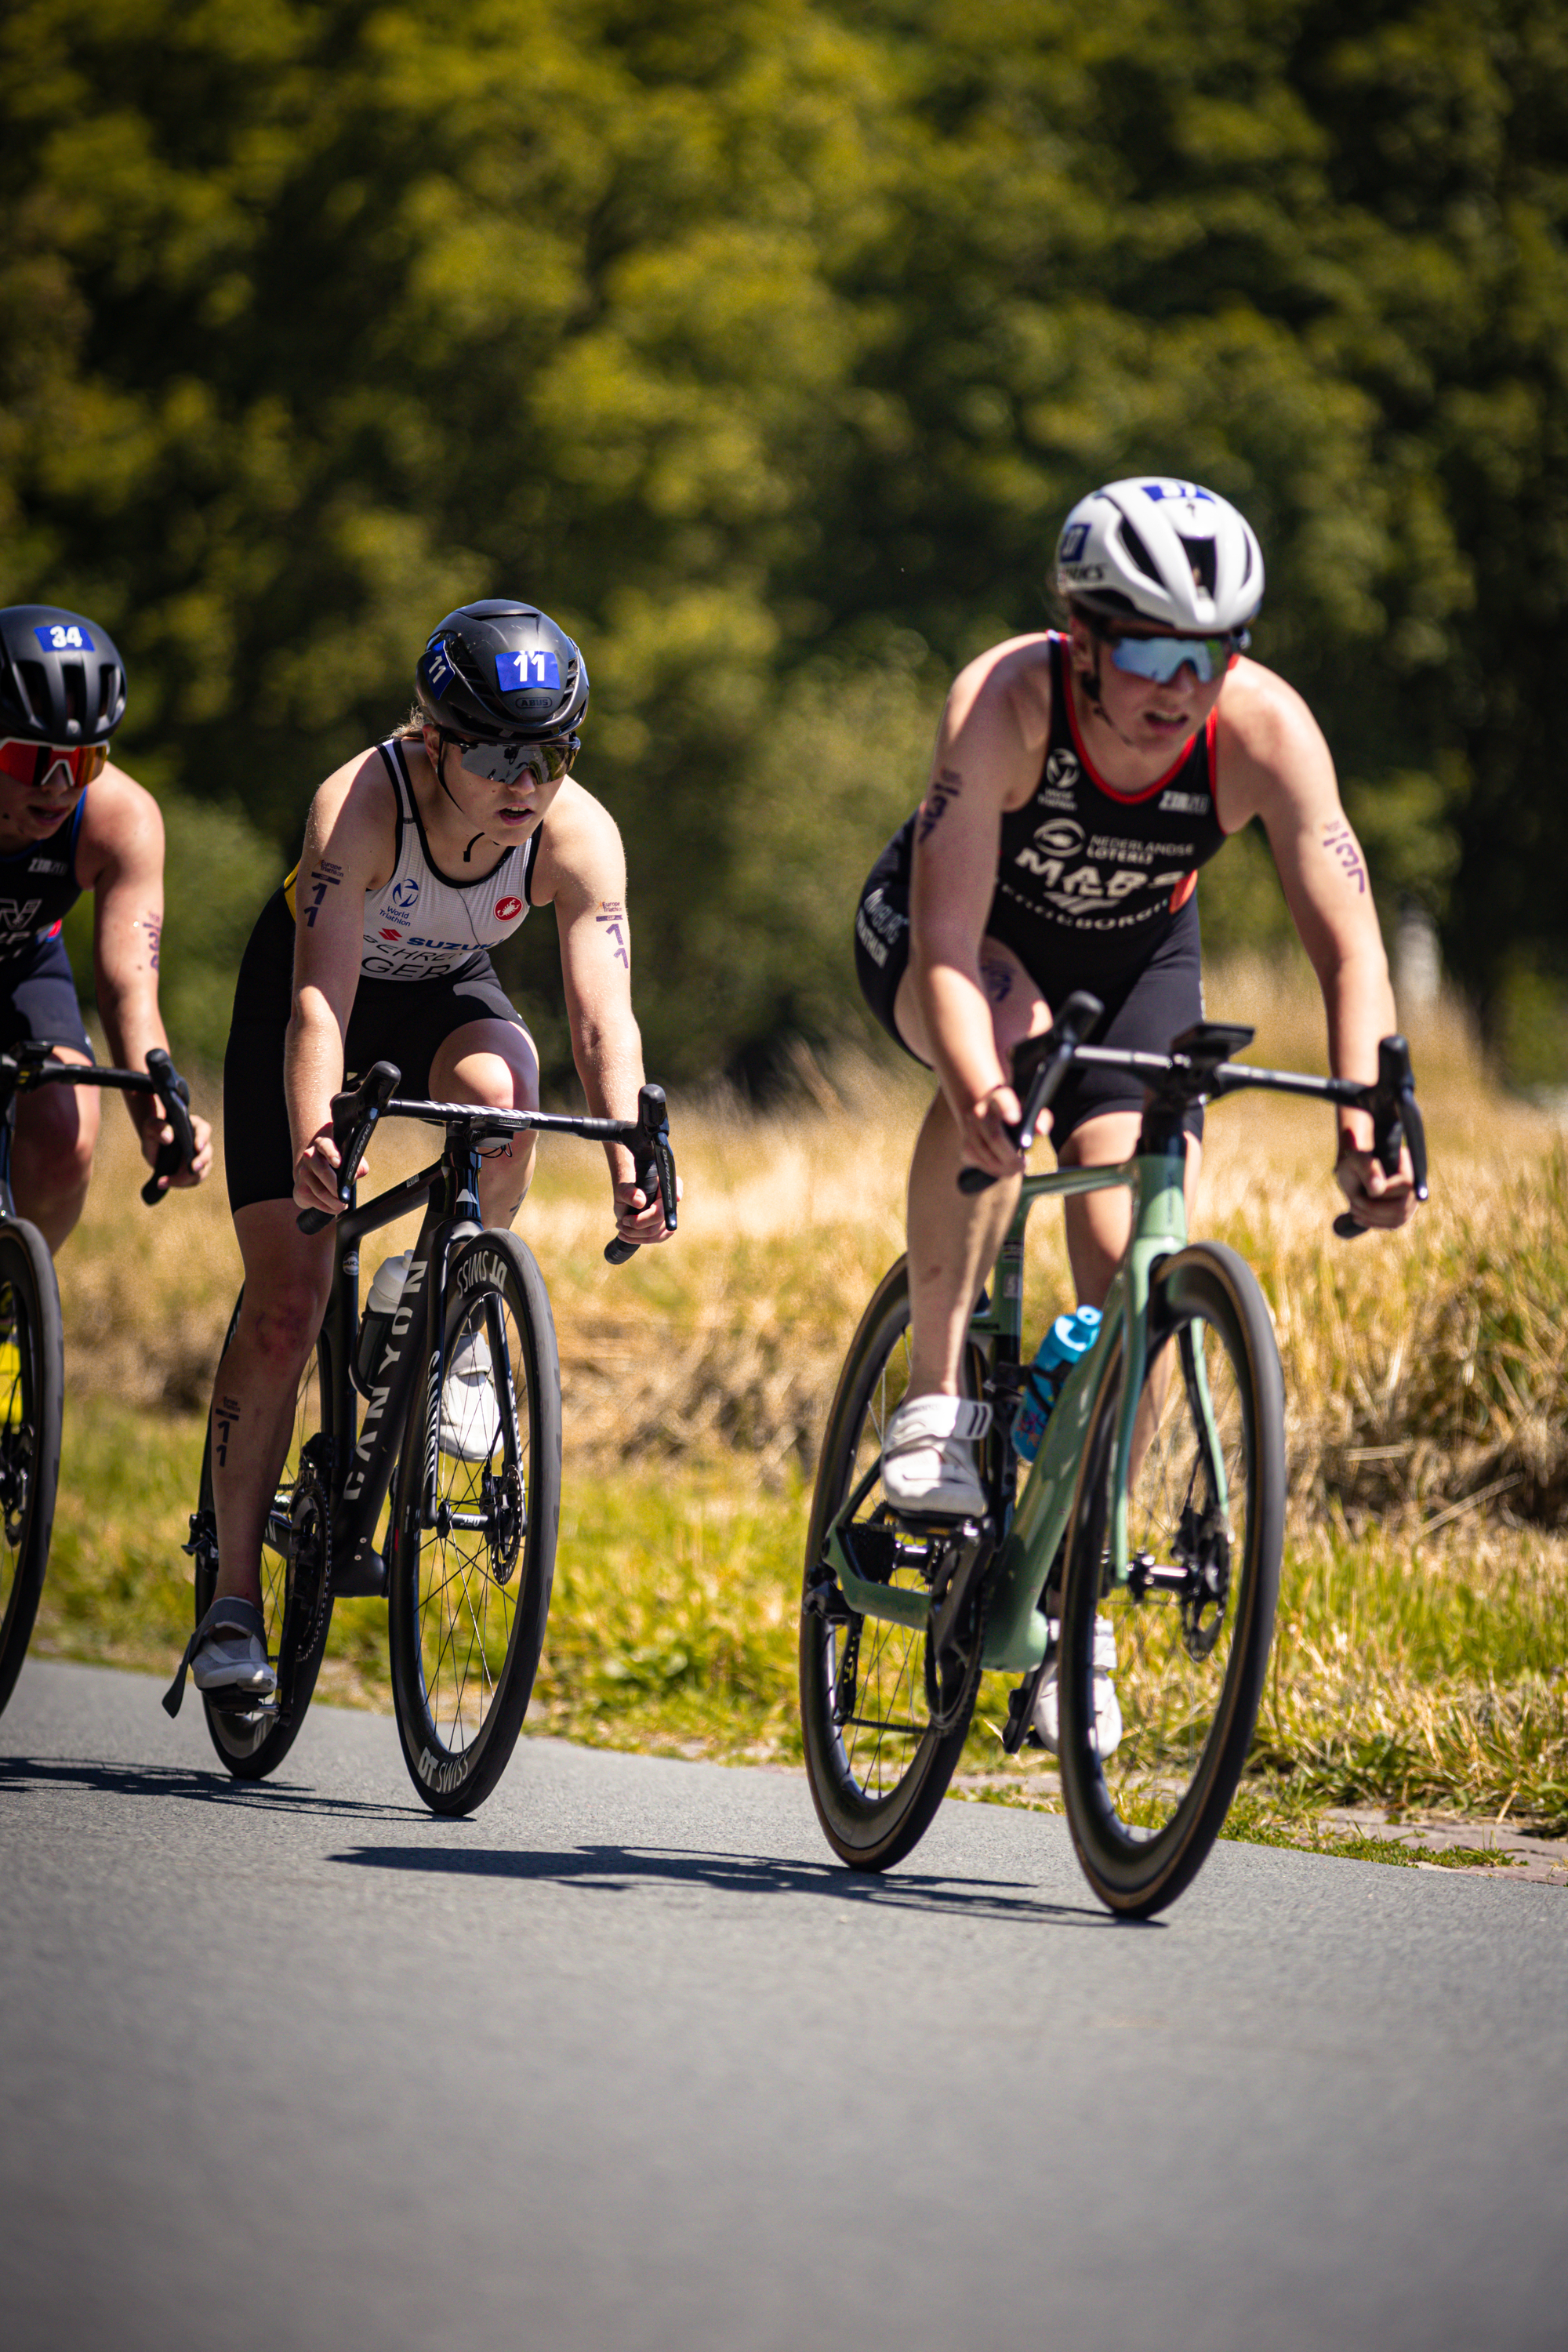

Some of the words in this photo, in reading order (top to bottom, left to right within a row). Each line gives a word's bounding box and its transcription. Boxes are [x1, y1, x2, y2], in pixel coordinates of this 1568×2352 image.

[49, 626, 83, 648] 34
[428, 655, 447, 684] 11
[513, 653, 545, 682] 11
[520, 699, 550, 707] ABUS
[321, 859, 342, 871] Europe
[1336, 843, 1365, 893] 37
[304, 882, 328, 928] 11
[379, 909, 411, 927] Triathlon
[387, 906, 409, 920] World
[605, 924, 629, 969] 11
[361, 956, 452, 978] GER
[499, 1117, 522, 1126] GARMIN
[343, 1261, 429, 1500] CANYON
[216, 1420, 230, 1468] 11
[417, 1746, 439, 1788] DT
[436, 1747, 470, 1794] SWISS
